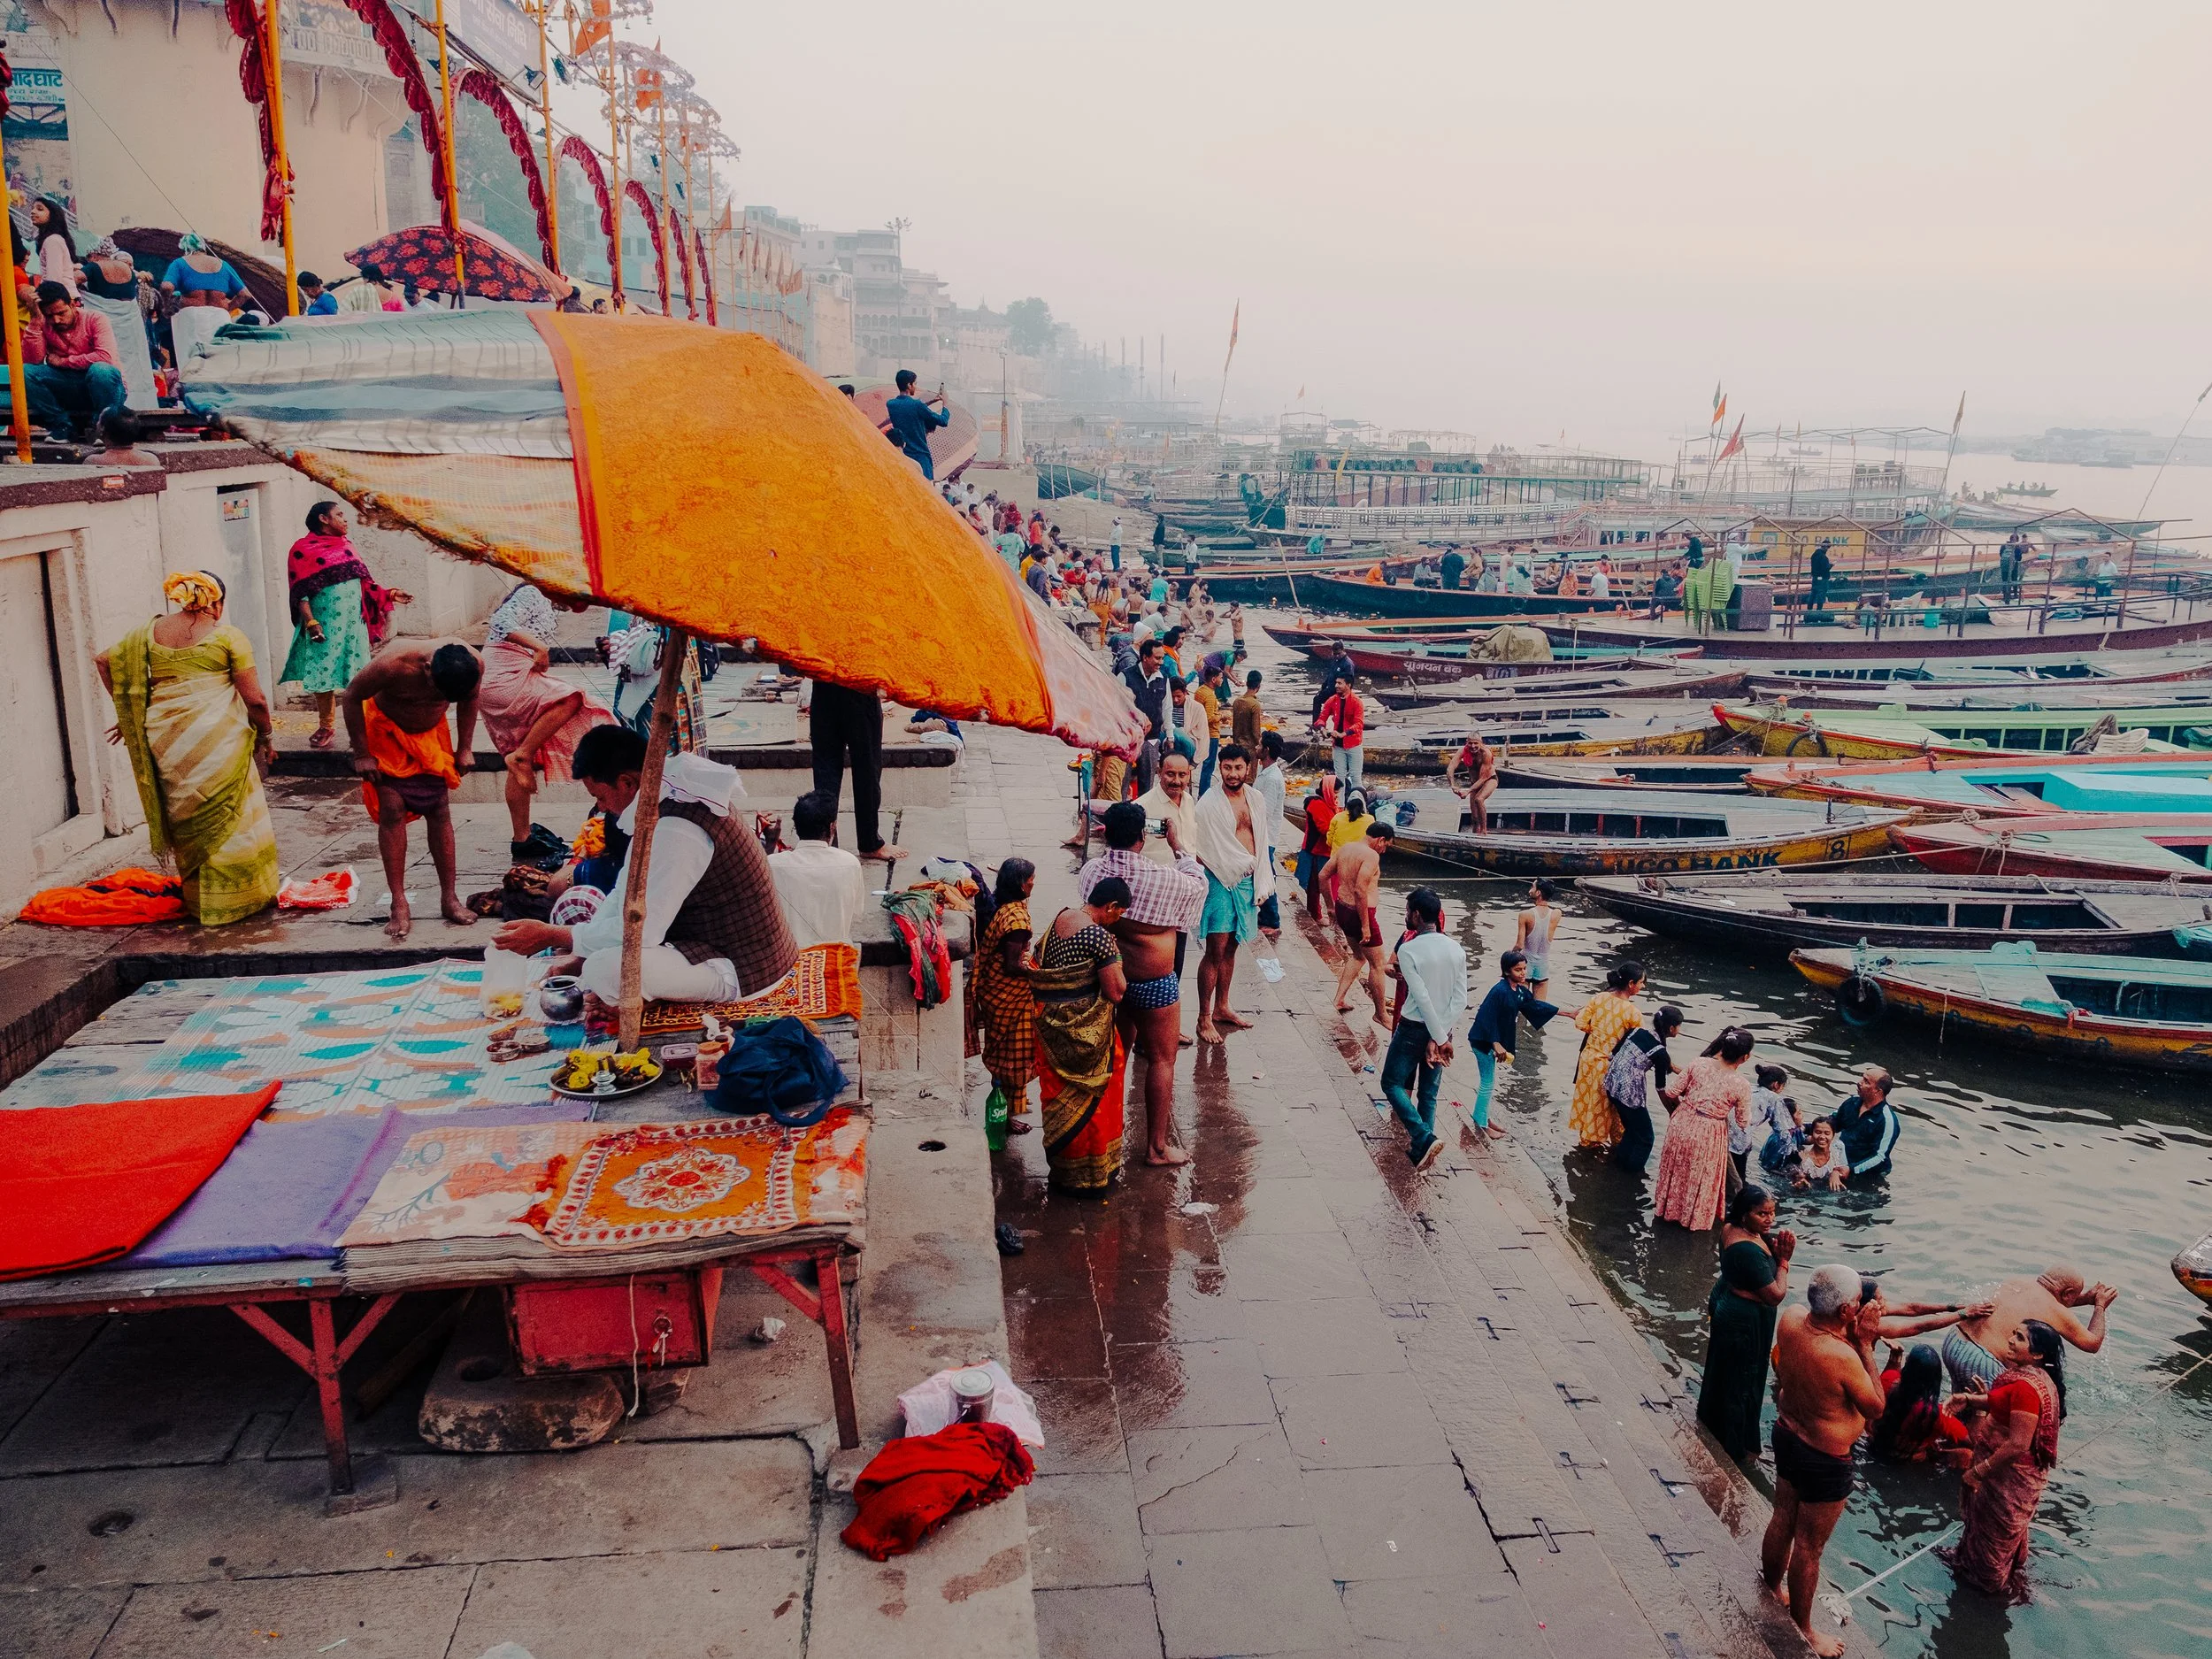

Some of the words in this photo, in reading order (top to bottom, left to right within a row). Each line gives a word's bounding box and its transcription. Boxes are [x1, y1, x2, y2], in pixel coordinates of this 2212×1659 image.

[1617, 856, 1679, 874] UCO
[1690, 851, 1782, 872] BANK
[1830, 841, 1846, 862] 8
